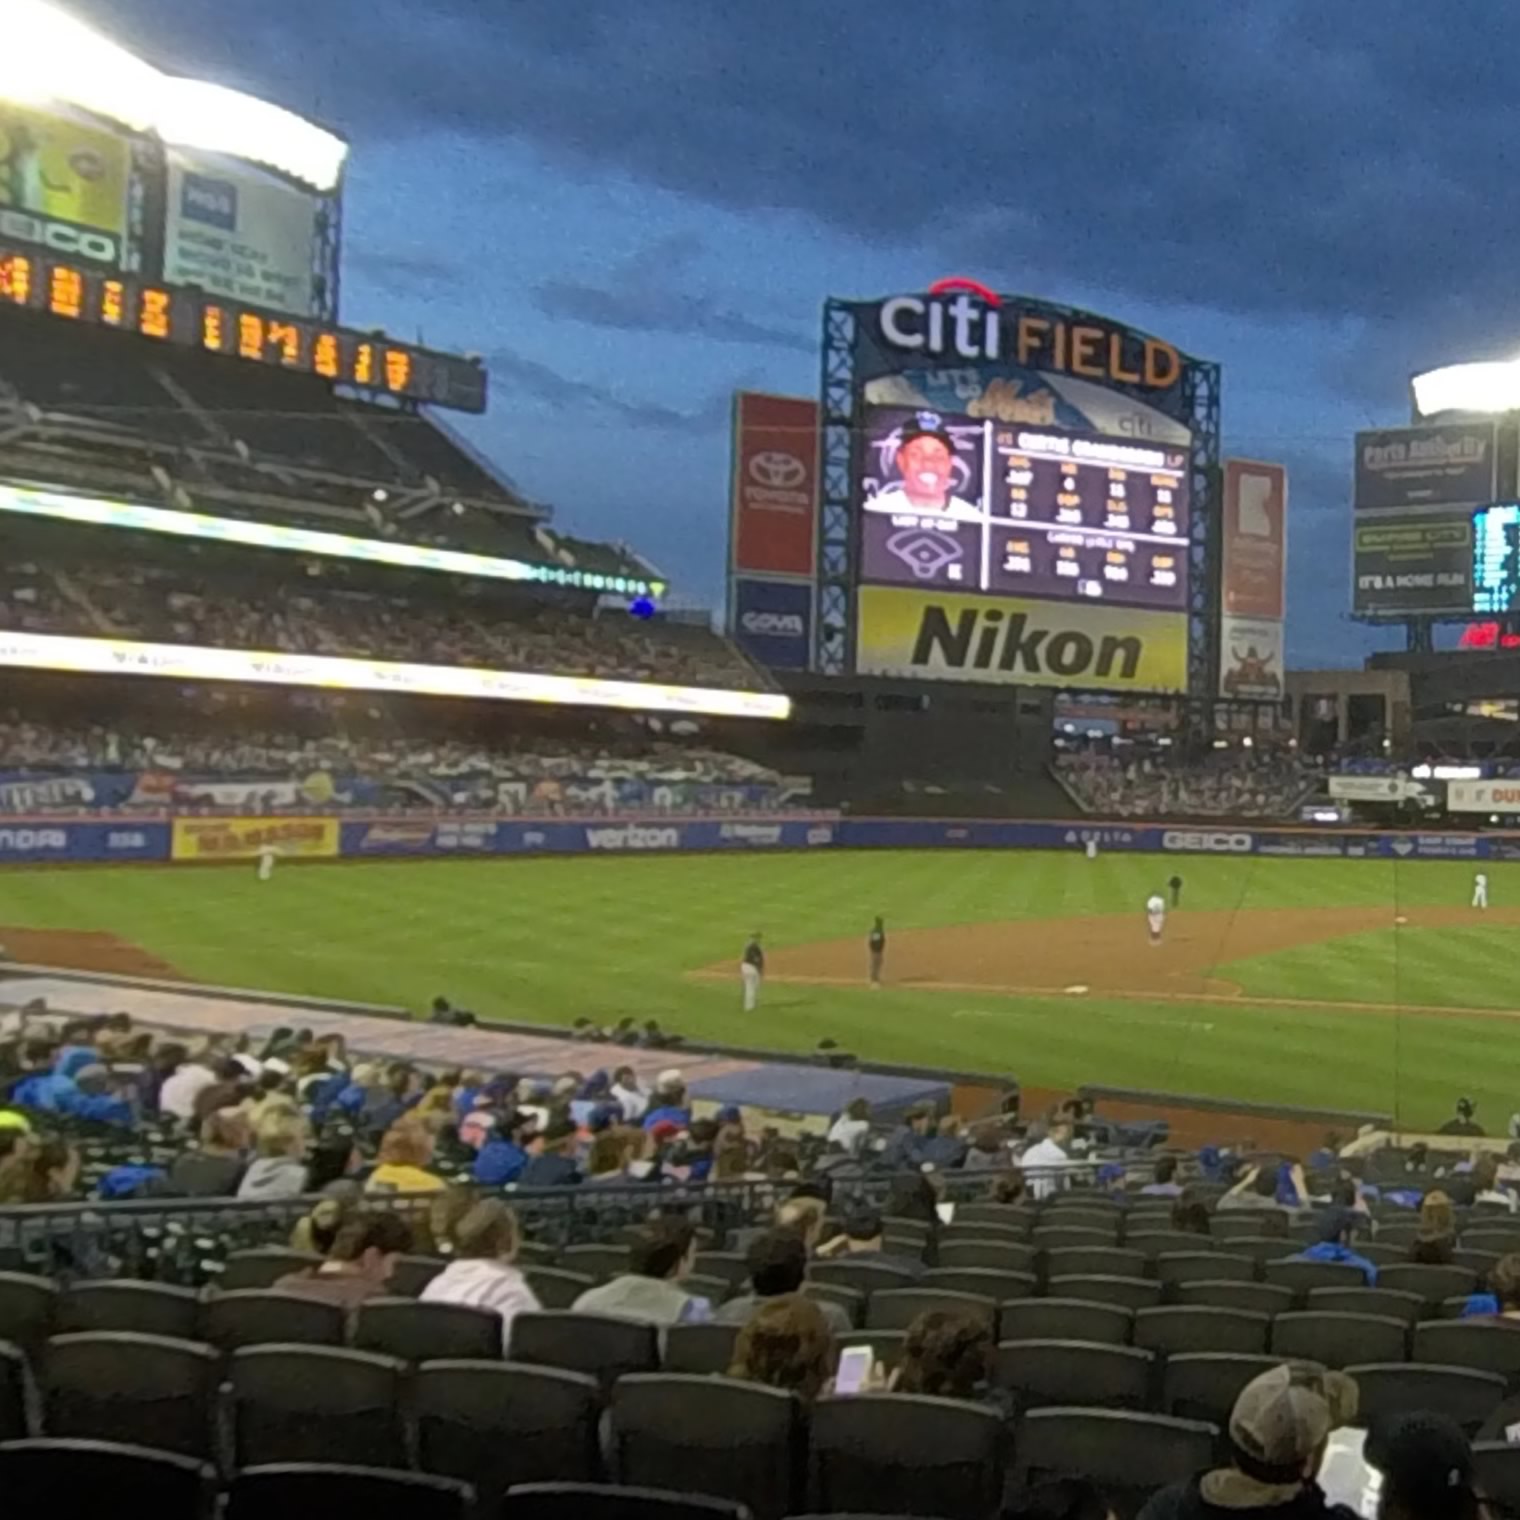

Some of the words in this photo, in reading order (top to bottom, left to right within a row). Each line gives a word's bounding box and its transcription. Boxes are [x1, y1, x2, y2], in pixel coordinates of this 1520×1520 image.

[1018, 317, 1180, 389] FIELD
[911, 605, 1143, 679] Nikon
[586, 822, 678, 849] verizon
[1162, 831, 1253, 851] GEICO
